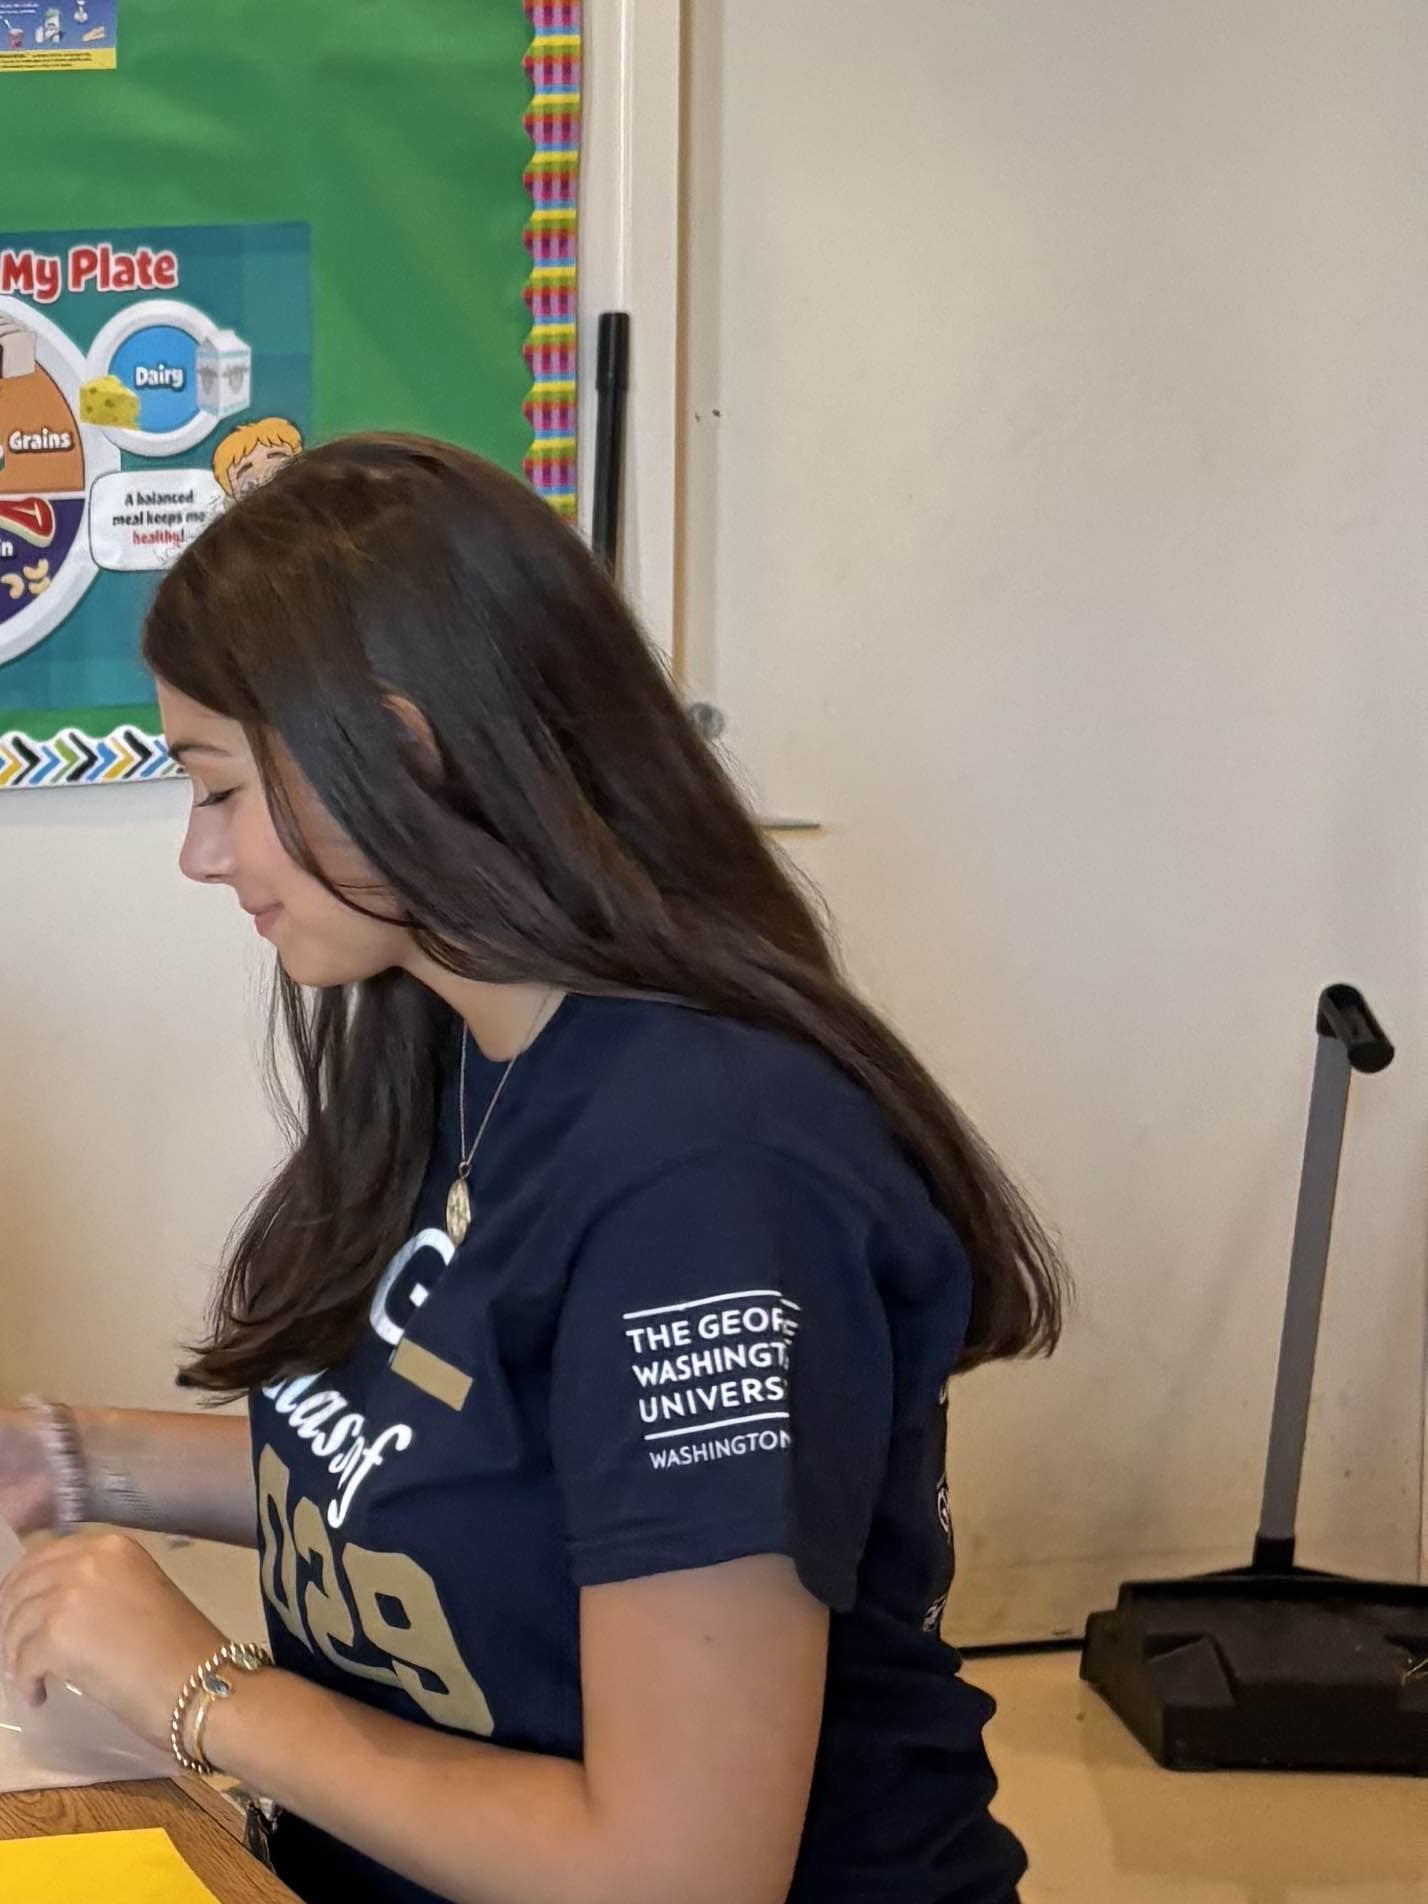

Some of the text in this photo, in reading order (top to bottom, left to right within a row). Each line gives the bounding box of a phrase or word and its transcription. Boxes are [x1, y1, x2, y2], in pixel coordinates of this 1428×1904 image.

[1, 248, 59, 300] My
[68, 244, 178, 293] Plate
[135, 365, 183, 388] Dairy
[9, 428, 71, 450] Grains
[125, 489, 194, 506] A balanced
[112, 511, 205, 528] meal keeps me
[626, 1320, 692, 1353] THE
[632, 1342, 789, 1387] WASHINGT
[639, 1376, 787, 1423] UNIVERS
